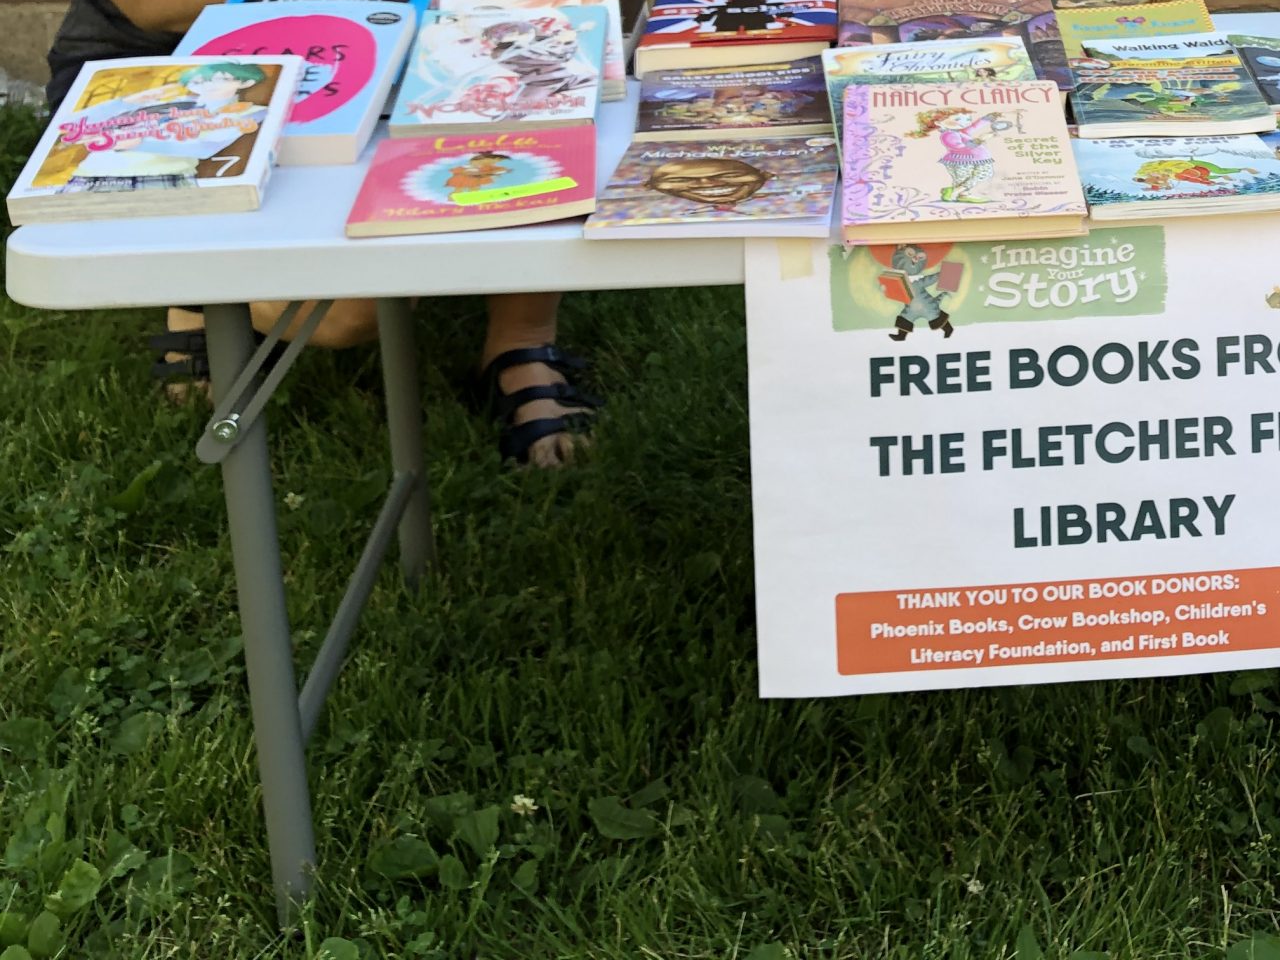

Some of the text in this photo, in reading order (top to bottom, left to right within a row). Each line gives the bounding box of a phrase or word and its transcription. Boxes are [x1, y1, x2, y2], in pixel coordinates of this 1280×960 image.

[1113, 42, 1180, 53] Walking
[877, 51, 945, 67] Fairy
[890, 57, 992, 73] Chronicles
[716, 70, 772, 80] SCHOOL
[873, 87, 1053, 107] NANCY CLANCY
[1003, 136, 1059, 144] Secret
[640, 146, 825, 159] Michael Jordan?
[1015, 150, 1062, 158] Silver
[1032, 157, 1063, 165] Key
[210, 156, 241, 177] 7
[991, 243, 1136, 270] Imagine
[1047, 268, 1085, 281] Your
[984, 266, 1139, 308] Story
[869, 351, 992, 398] FREE
[1009, 339, 1201, 390] BOOKS
[869, 433, 965, 477] THE
[982, 416, 1236, 471] FLETCHER
[1013, 495, 1236, 549] LIBRARY
[896, 574, 1240, 610] THANK YOU TO OUR BOOK DONORS:
[870, 600, 1267, 638] Phoenix Books, Crow Bookshop, Children's
[910, 630, 1229, 664] Literacy Foundation, and First Book
